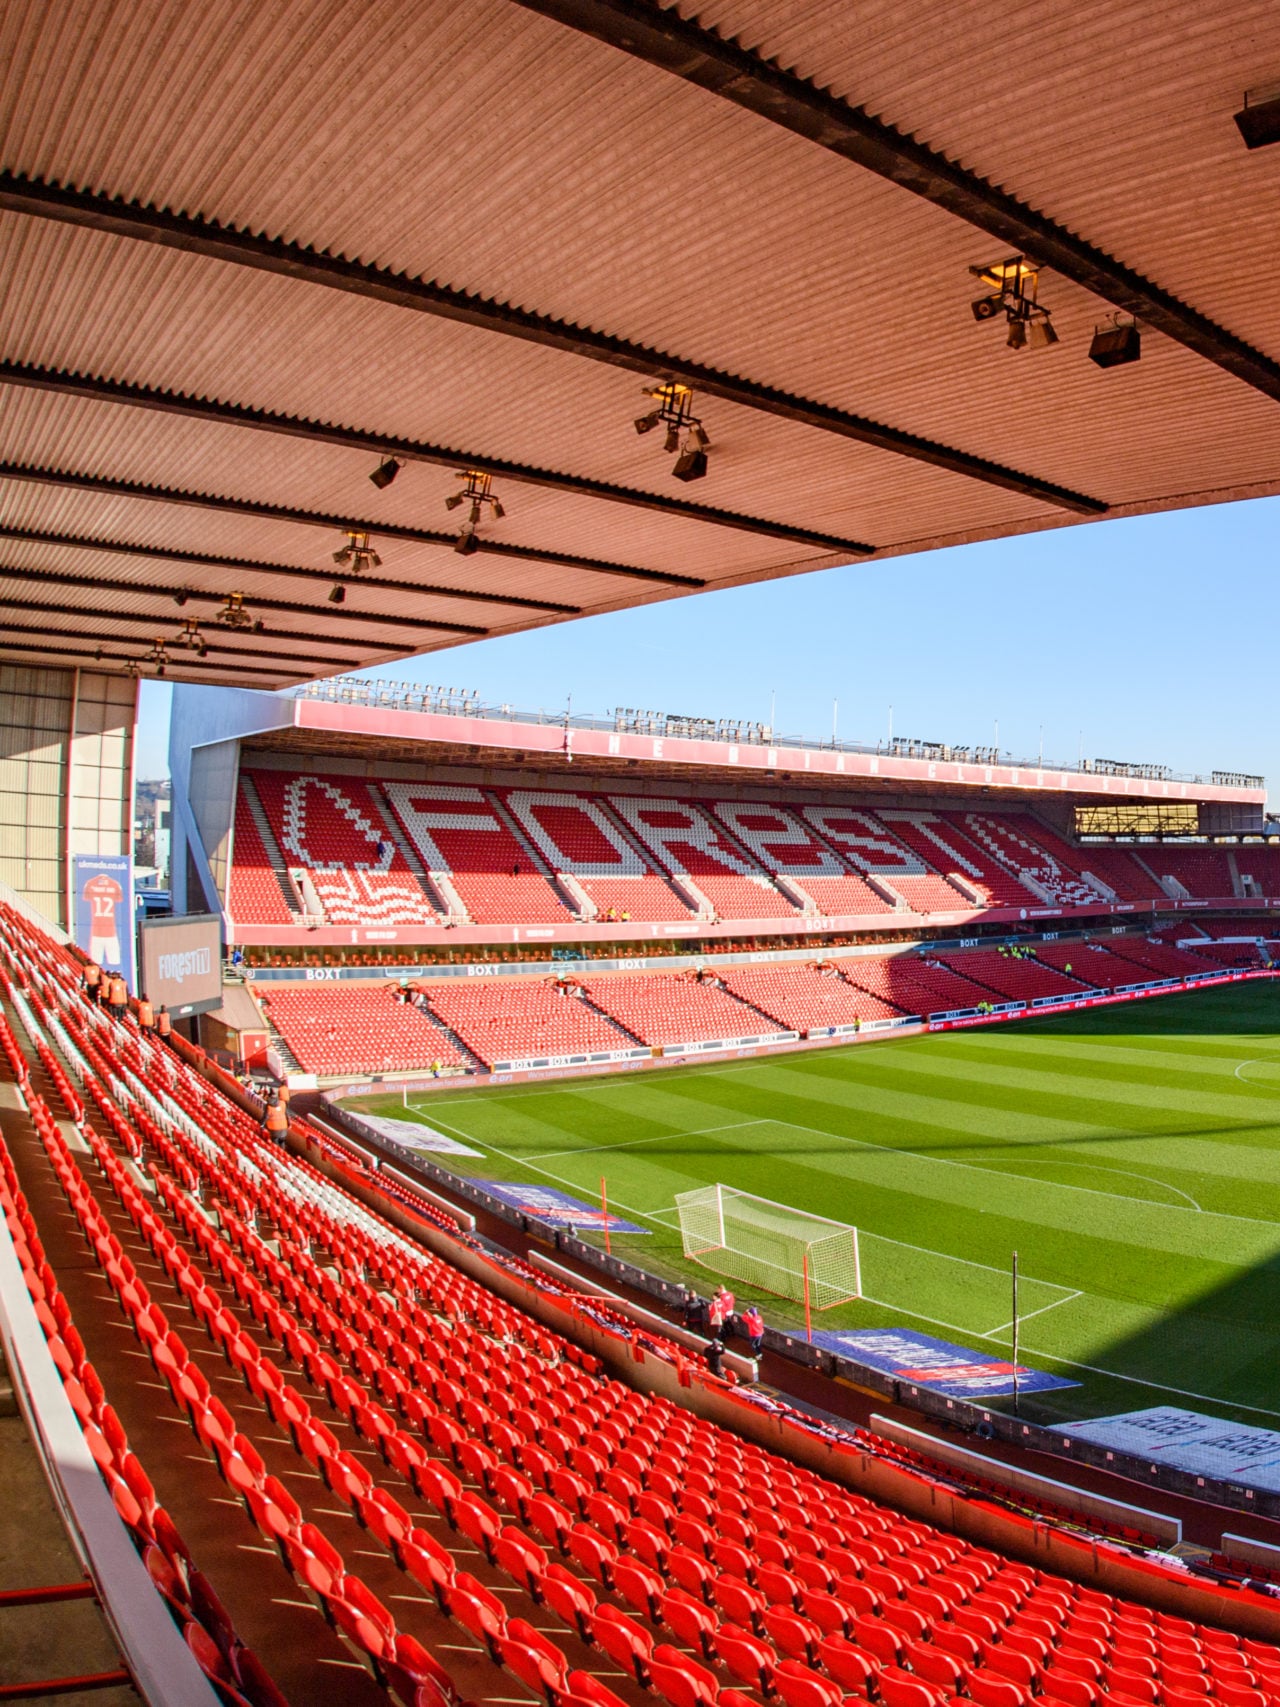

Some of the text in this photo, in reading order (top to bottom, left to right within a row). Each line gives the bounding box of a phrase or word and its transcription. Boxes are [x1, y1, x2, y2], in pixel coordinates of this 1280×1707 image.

[93, 896, 115, 918] 12
[806, 918, 835, 930] BOXT
[1112, 926, 1126, 934] BOXT
[1042, 932, 1060, 941] BOXT
[960, 938, 979, 948] BOXT
[750, 952, 775, 962] BOXT
[618, 959, 647, 970] BOXT
[306, 969, 342, 980] BOXT
[467, 965, 500, 976] BOXT
